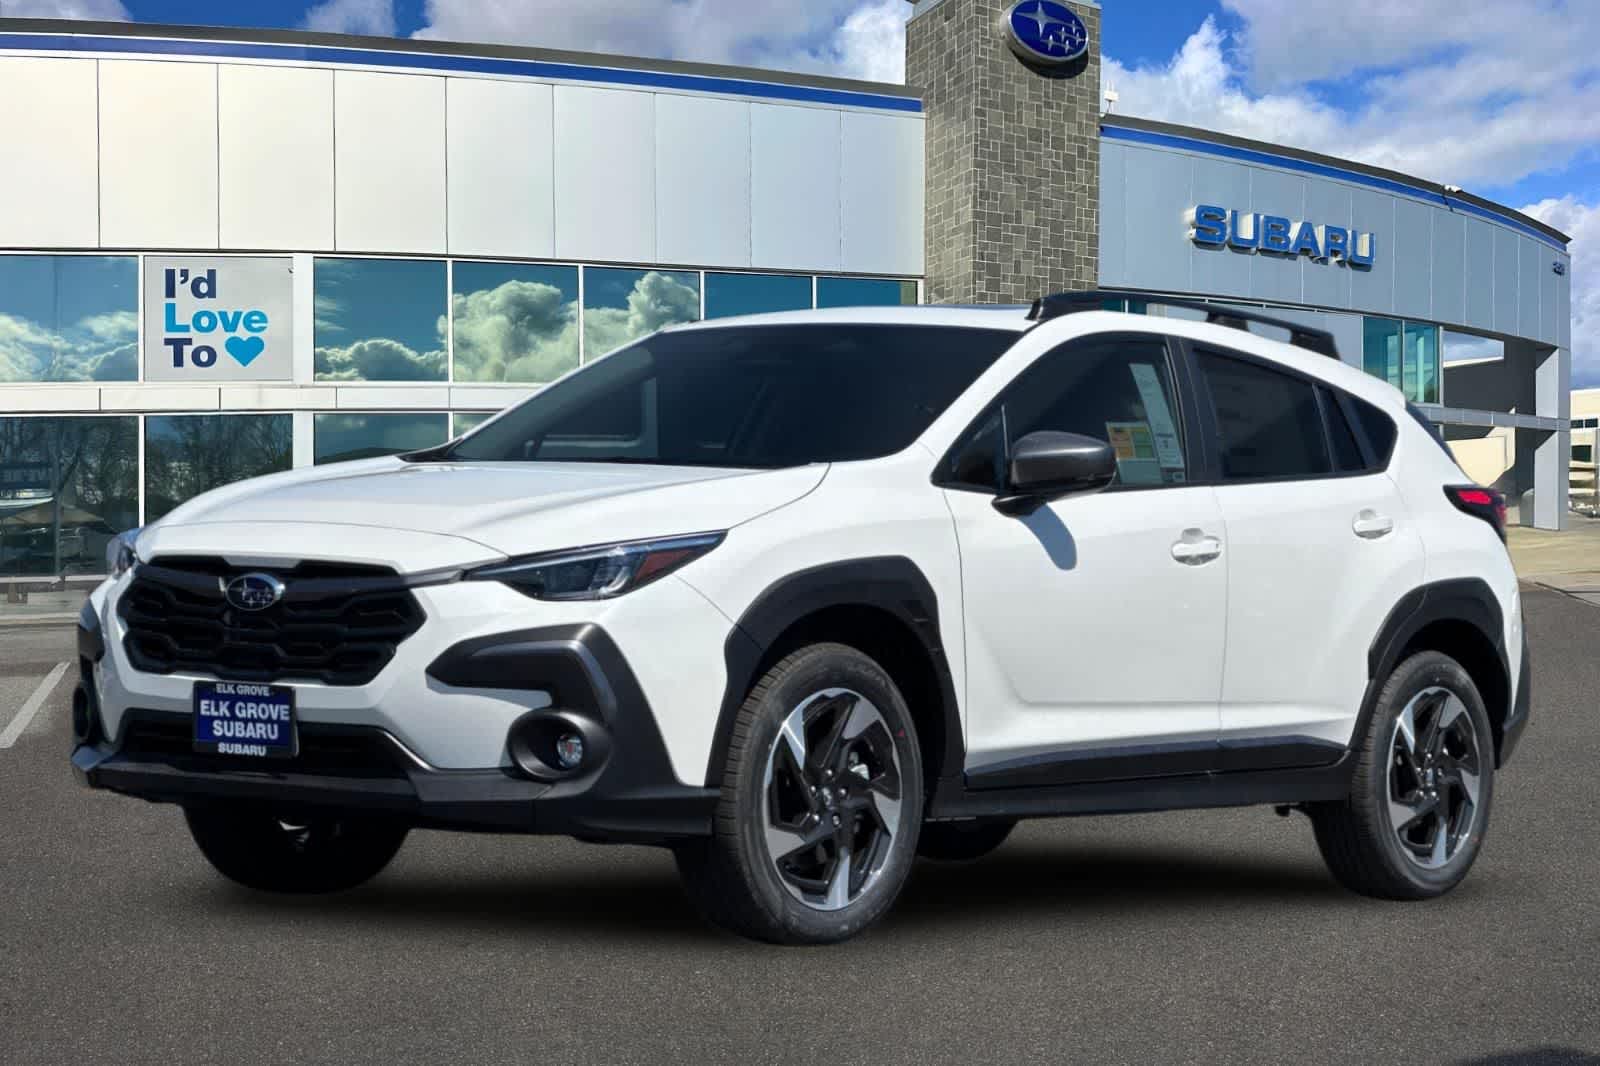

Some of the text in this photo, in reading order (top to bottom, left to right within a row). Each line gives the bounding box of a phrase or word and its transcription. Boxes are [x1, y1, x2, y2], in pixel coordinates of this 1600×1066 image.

[1191, 204, 1376, 269] SUBARU
[164, 268, 217, 299] I'd
[164, 302, 268, 333] Love
[163, 337, 217, 368] To
[216, 683, 270, 697] ELK GROVE
[200, 700, 290, 721] ELK GROVE
[212, 720, 279, 740] SUBARU
[217, 741, 267, 757] SUBARU
